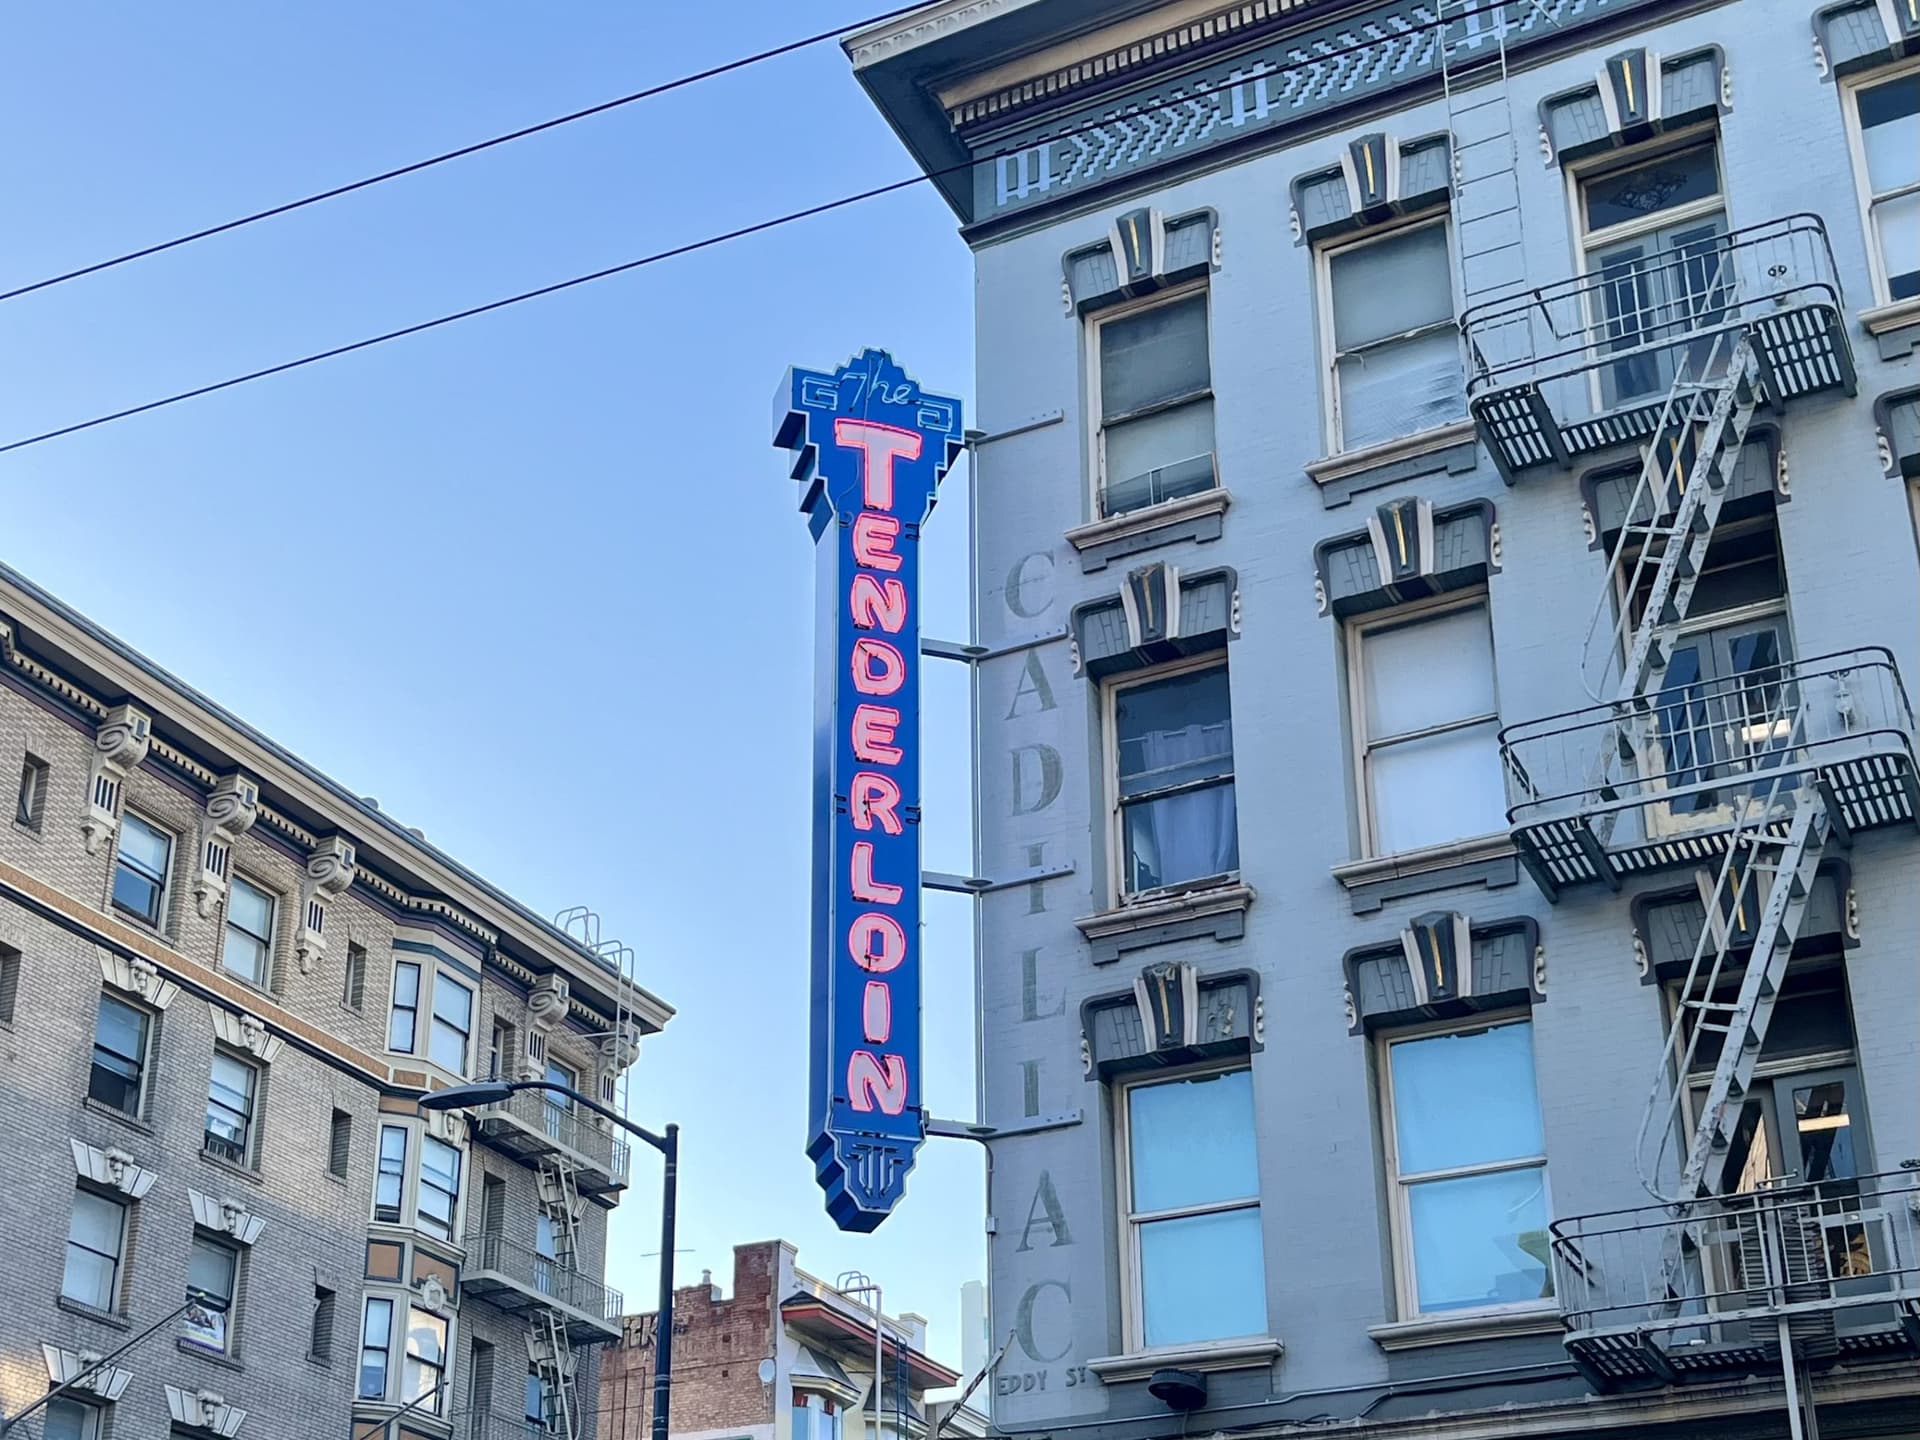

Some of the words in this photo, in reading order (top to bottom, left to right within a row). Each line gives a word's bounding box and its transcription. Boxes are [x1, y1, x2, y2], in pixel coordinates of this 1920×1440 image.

[841, 356, 913, 411] The
[834, 418, 922, 1114] TENDERLOIN
[1004, 550, 1074, 1363] CADILLAC
[997, 1370, 1047, 1396] EDDY
